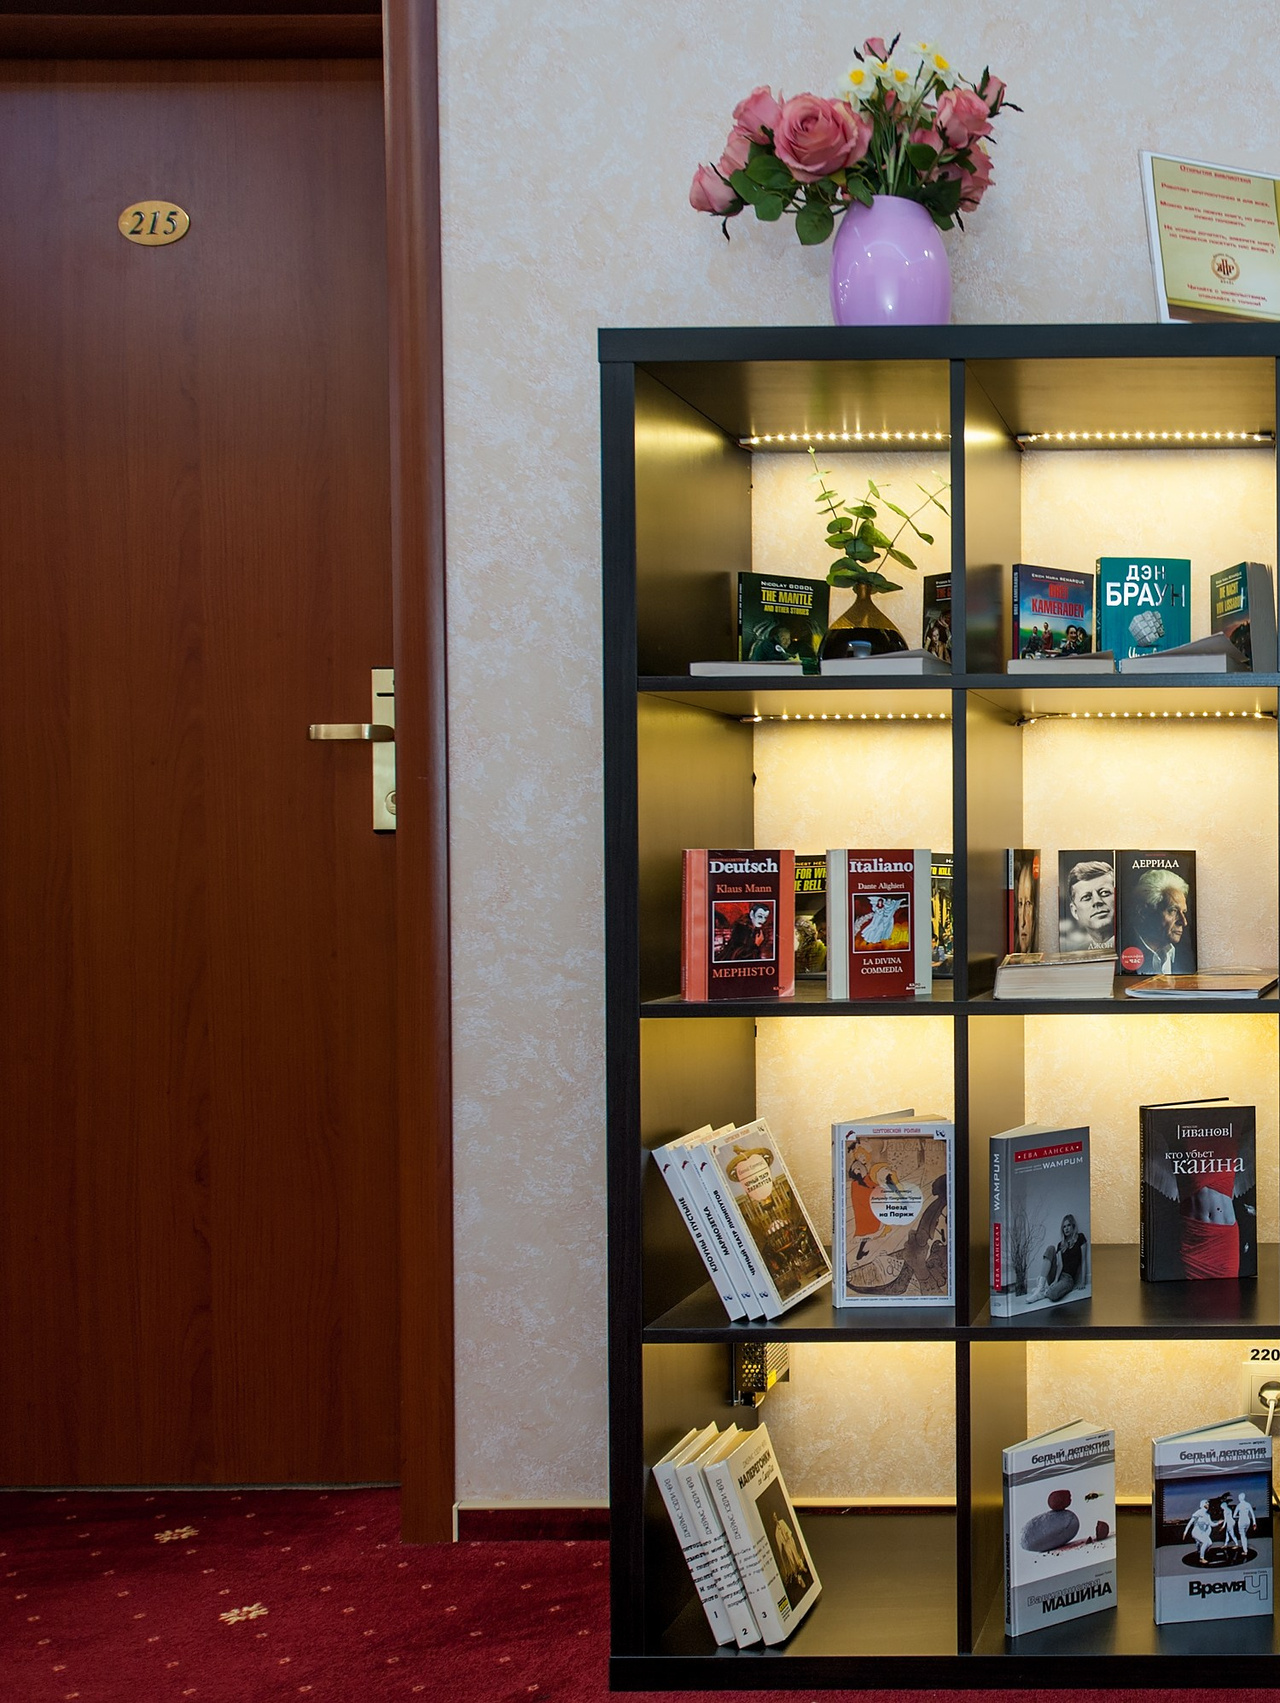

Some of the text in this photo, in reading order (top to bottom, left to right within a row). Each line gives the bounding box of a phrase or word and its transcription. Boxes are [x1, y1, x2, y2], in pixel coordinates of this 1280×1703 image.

[129, 210, 179, 235] 215
[1125, 564, 1165, 581] ДЭН
[761, 589, 813, 606] THE MANTLE
[1048, 583, 1069, 599] DREI
[1106, 582, 1186, 608] БРАУН
[1031, 598, 1085, 618] KAMERADEN
[709, 858, 779, 873] Deutsch
[849, 858, 913, 873] Italiano
[938, 867, 952, 876] KILL
[1132, 859, 1180, 869] ДЕРРИДА
[795, 868, 812, 879] FOR
[716, 884, 772, 893] Klaus Mann
[803, 879, 822, 891] BELL
[857, 882, 905, 891] Dante Alighieri
[875, 957, 902, 965] DIVINA
[712, 966, 776, 979] MEPHISTO
[860, 966, 904, 975] COMMEDIA
[1182, 1127, 1230, 1138] иванов
[1023, 1146, 1075, 1160] ЕВА ЛАНСКА
[1165, 1150, 1214, 1161] кто убьет
[1042, 1156, 1084, 1169] WAMPUM
[1173, 1157, 1246, 1174] каина
[678, 1197, 699, 1232] ПУСТЫНЕ
[889, 1211, 914, 1219] Париж
[703, 1206, 730, 1256] МАРМОЗЕТКА
[713, 1189, 756, 1276] ЧЕРНЫЙ ТЕАТР ЛИЛИПУТОВ
[699, 1239, 719, 1273] КЛОУНЫ
[1031, 1448, 1066, 1464] белый
[1067, 1440, 1111, 1456] детектив
[1180, 1449, 1216, 1461] белый
[1219, 1447, 1267, 1458] детектив
[738, 1449, 771, 1489] НАПЕРЕГОНКИ
[1188, 1580, 1246, 1599] Время
[1042, 1582, 1112, 1614] МАШИНА
[713, 1611, 719, 1619] 1
